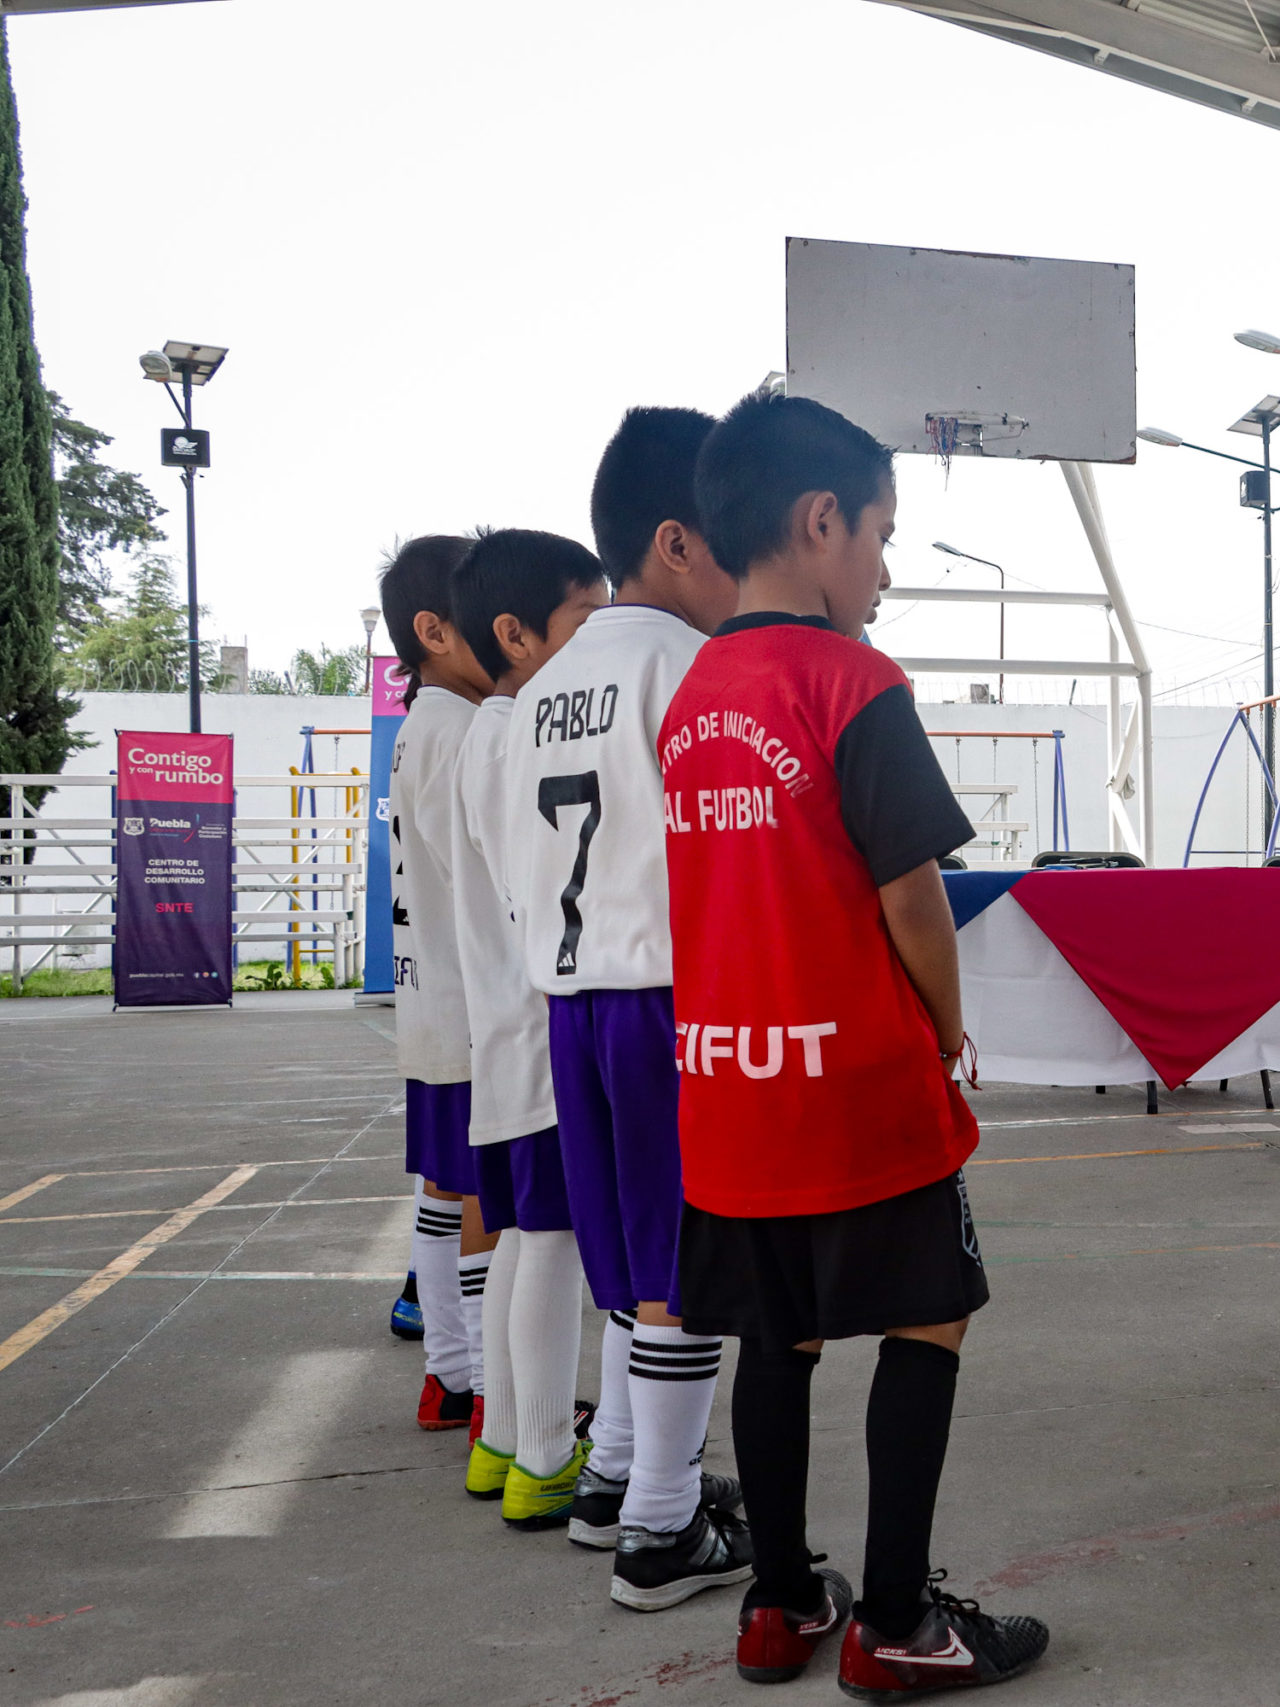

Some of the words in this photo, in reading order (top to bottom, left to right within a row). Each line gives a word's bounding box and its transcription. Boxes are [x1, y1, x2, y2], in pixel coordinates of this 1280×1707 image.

[536, 684, 618, 747] PABLO
[128, 748, 212, 771] Contigo
[662, 725, 692, 775] TRO
[697, 711, 719, 742] DE
[723, 710, 815, 798] INICIACION
[155, 768, 224, 784] rumbo
[149, 818, 191, 829] Puebla
[664, 791, 691, 833] AL
[698, 786, 778, 832] FUTBOL
[538, 770, 601, 976] 7
[155, 903, 194, 913] SNTE
